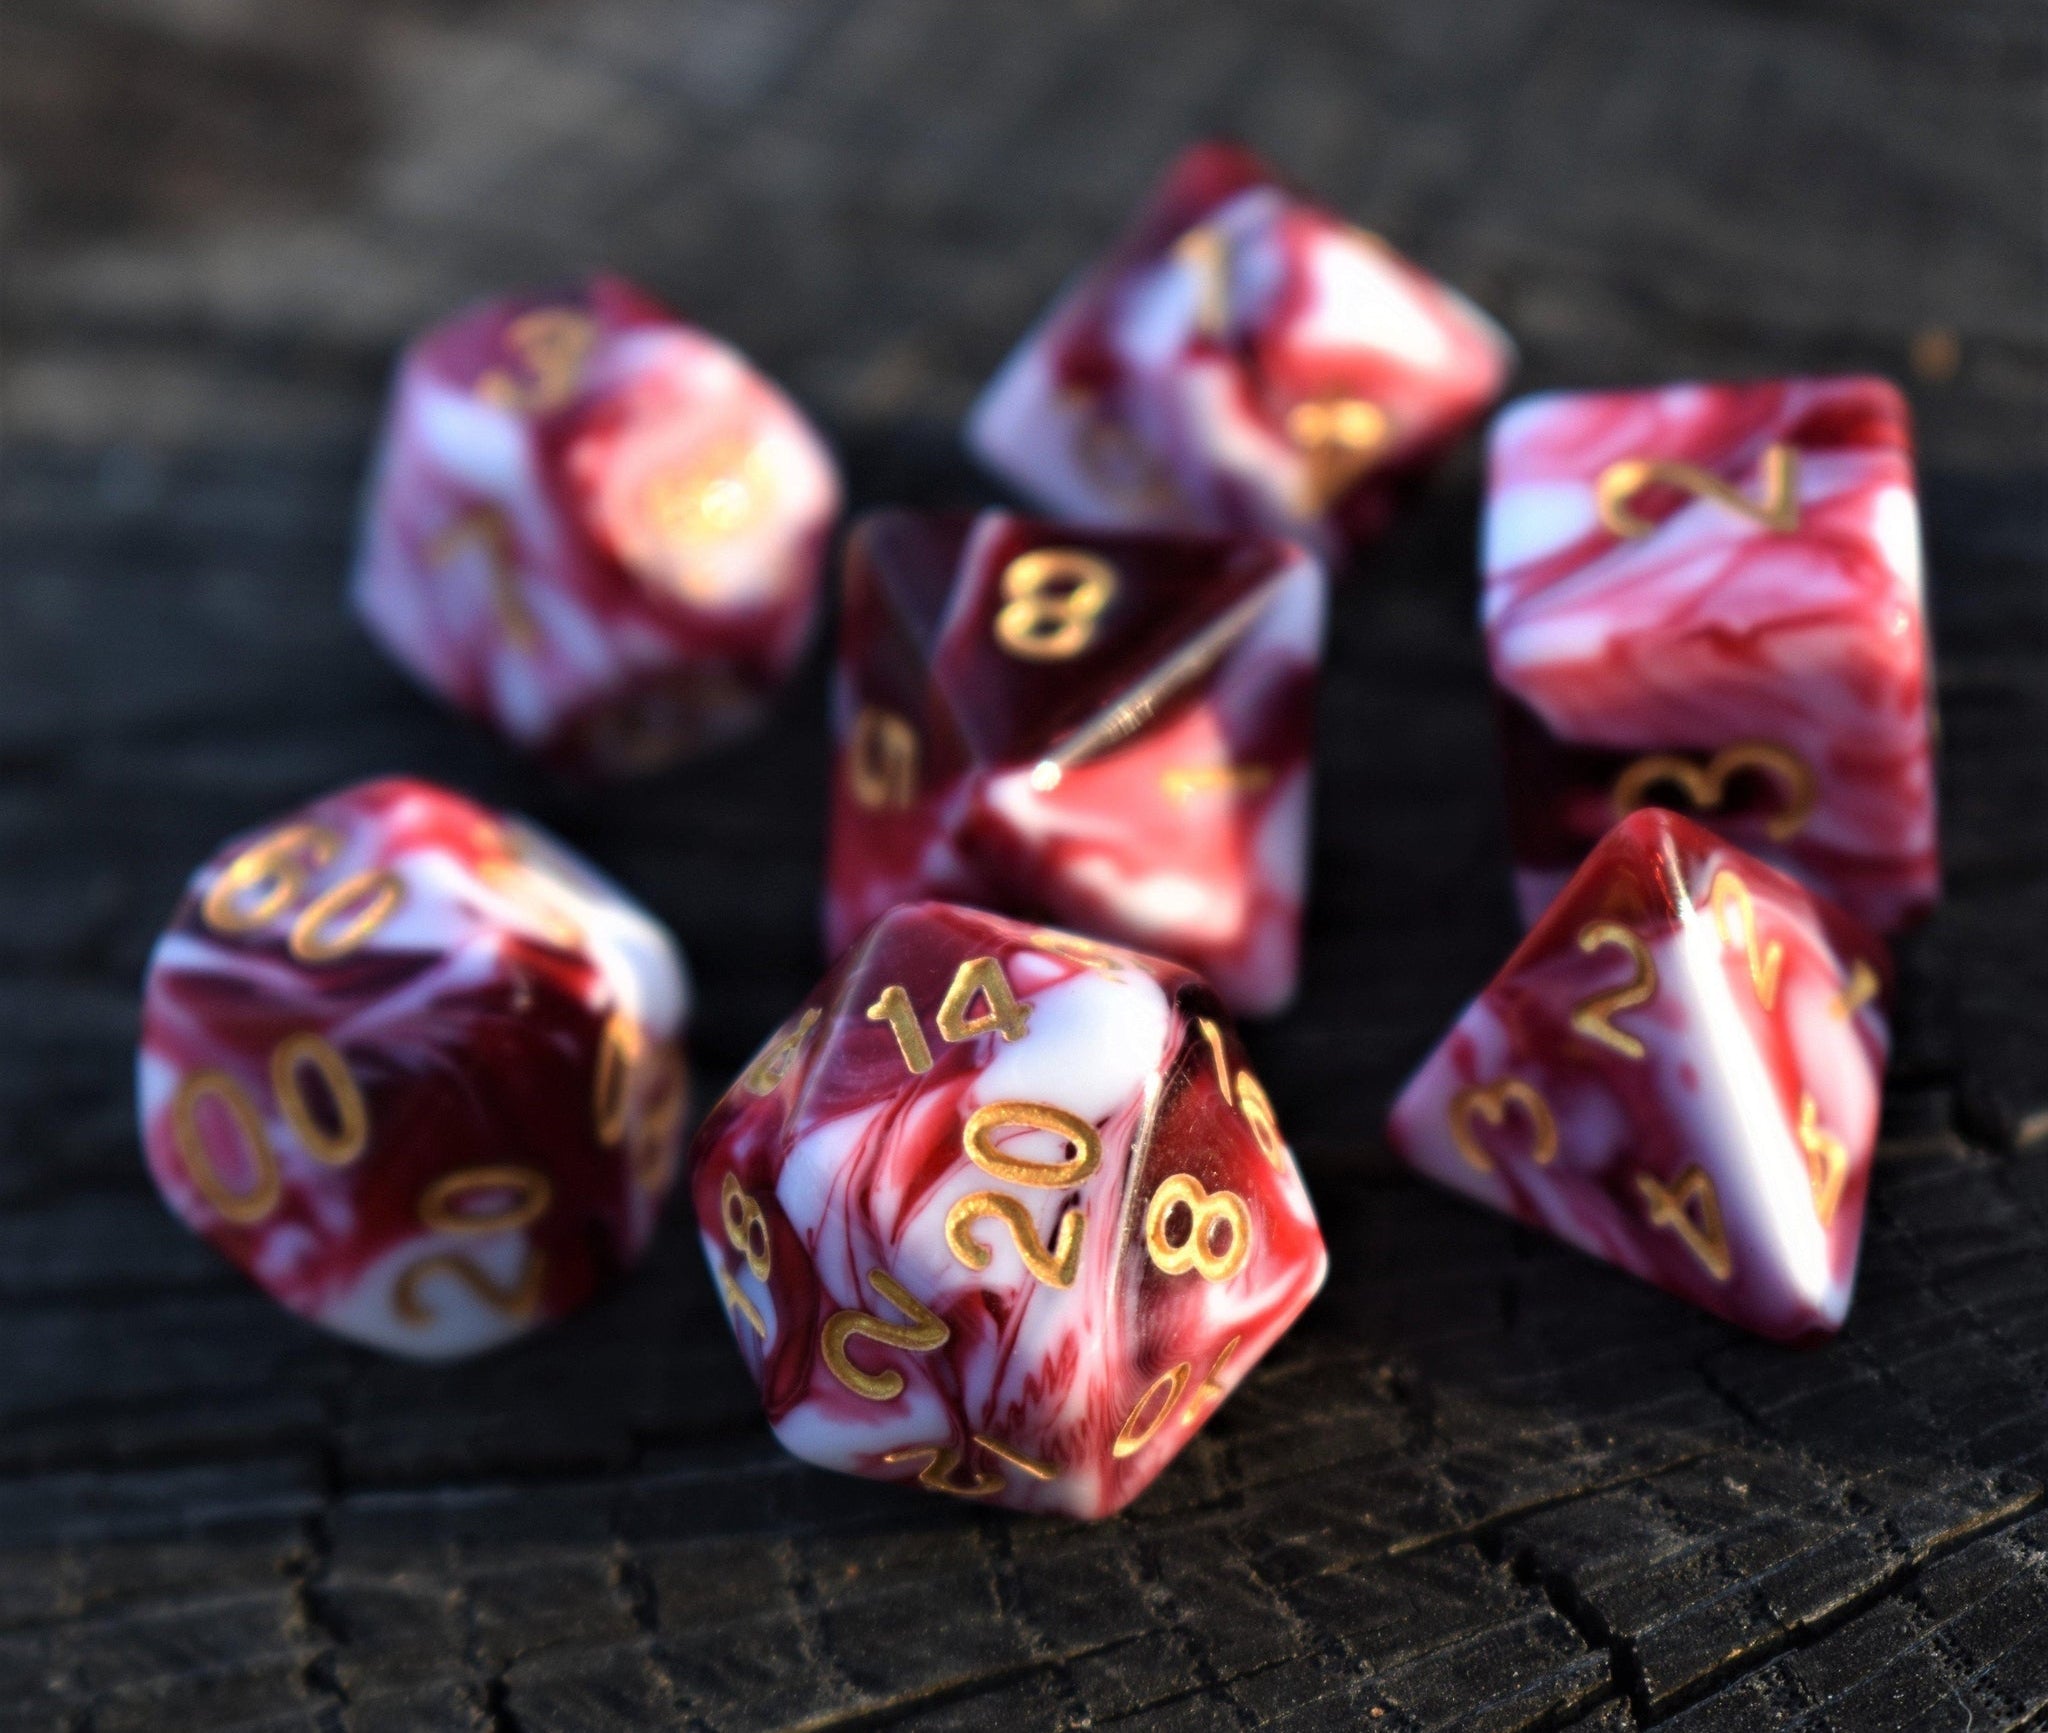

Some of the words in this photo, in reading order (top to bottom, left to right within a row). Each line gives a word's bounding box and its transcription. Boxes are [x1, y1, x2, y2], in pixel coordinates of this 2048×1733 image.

[1596, 443, 1801, 538] 2
[994, 549, 1118, 662] 8
[1613, 744, 1815, 842] 3
[204, 823, 404, 962] 60
[1711, 869, 1782, 1012] 2
[867, 957, 1033, 1074] 14
[1572, 921, 1658, 1059] 2
[172, 1032, 368, 1225] 00
[1449, 1079, 1558, 1173] 3
[1799, 1091, 1847, 1227] 4
[392, 1165, 550, 1330] 20
[945, 1100, 1100, 1289] 20
[1147, 1173, 1250, 1283] 8
[1635, 1165, 1732, 1281] 4
[821, 1268, 950, 1400] 2
